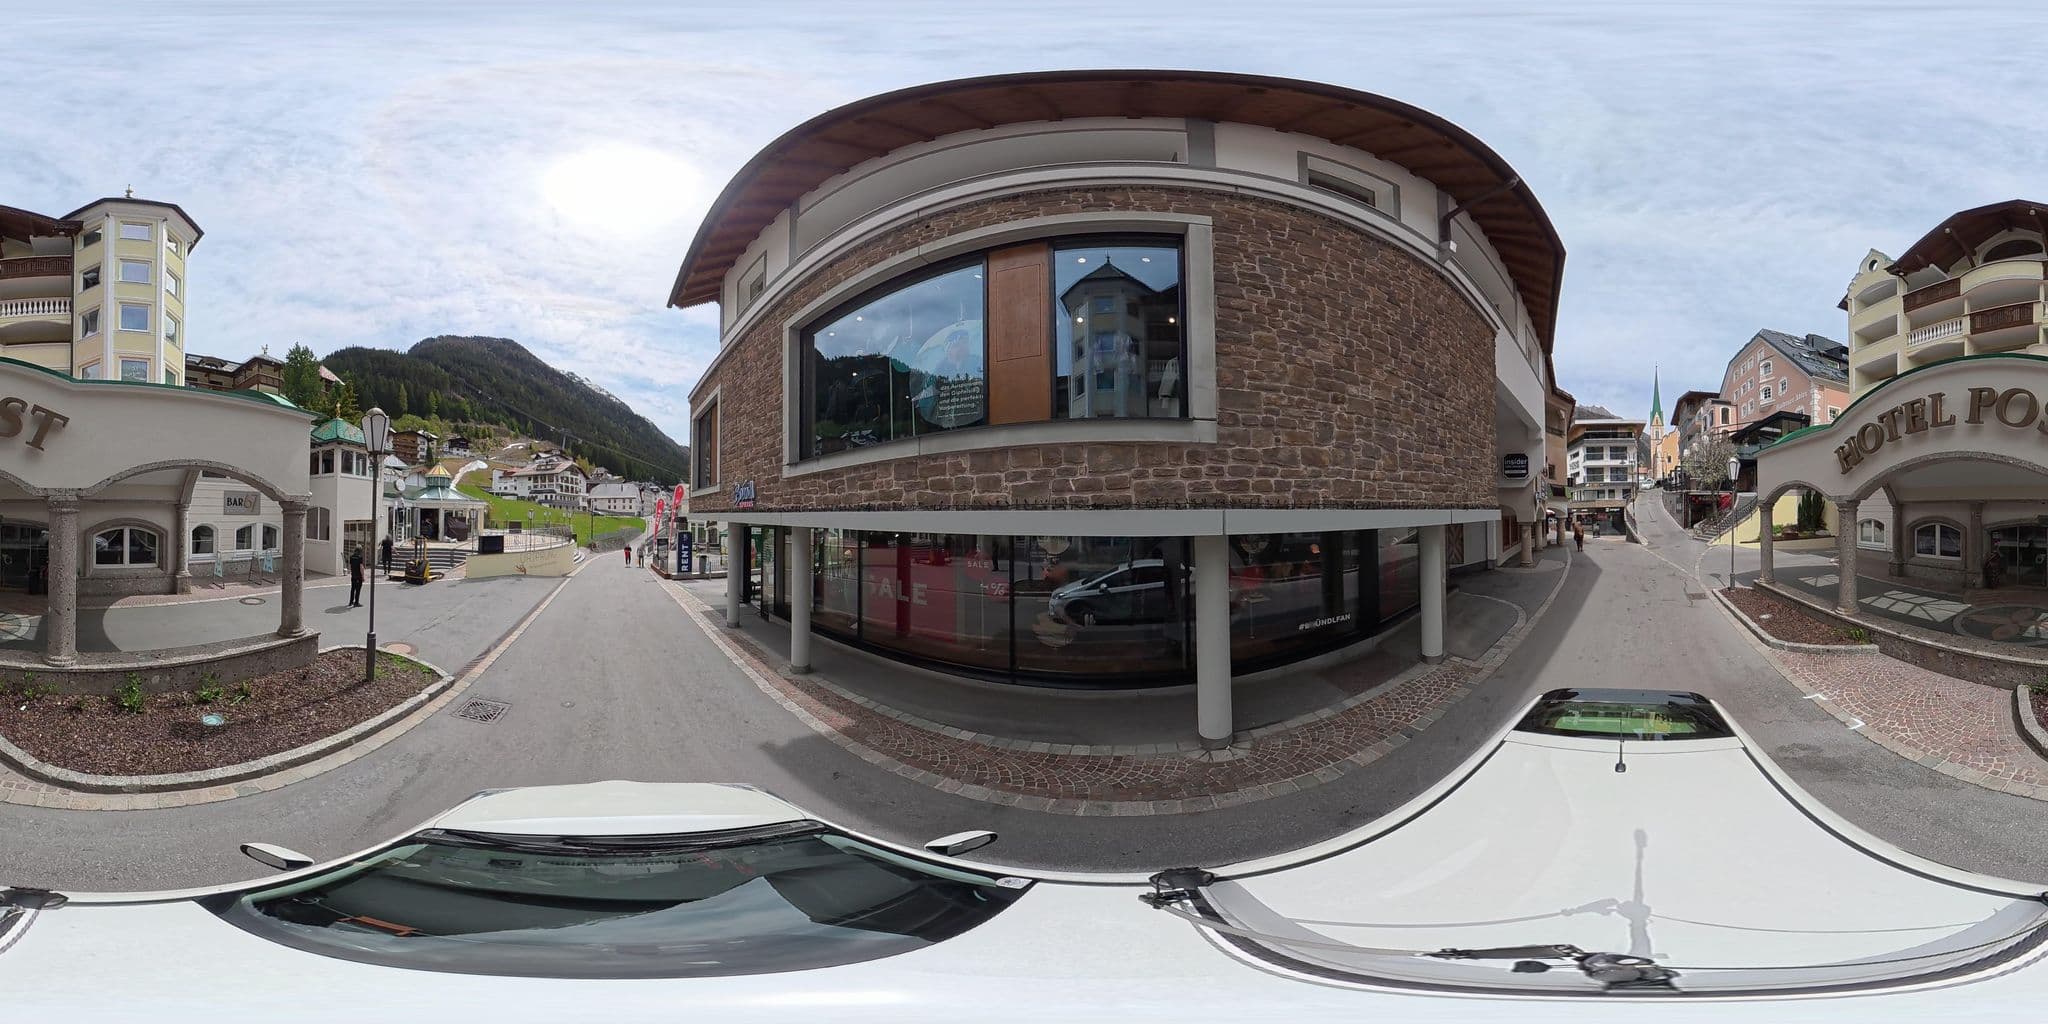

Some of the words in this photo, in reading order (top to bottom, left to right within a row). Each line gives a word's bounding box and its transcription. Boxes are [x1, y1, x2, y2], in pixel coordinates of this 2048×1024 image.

[1834, 392, 1957, 475] HOTEL
[226, 497, 244, 507] BAR
[681, 543, 689, 572] RENT
[967, 560, 990, 569] SALE
